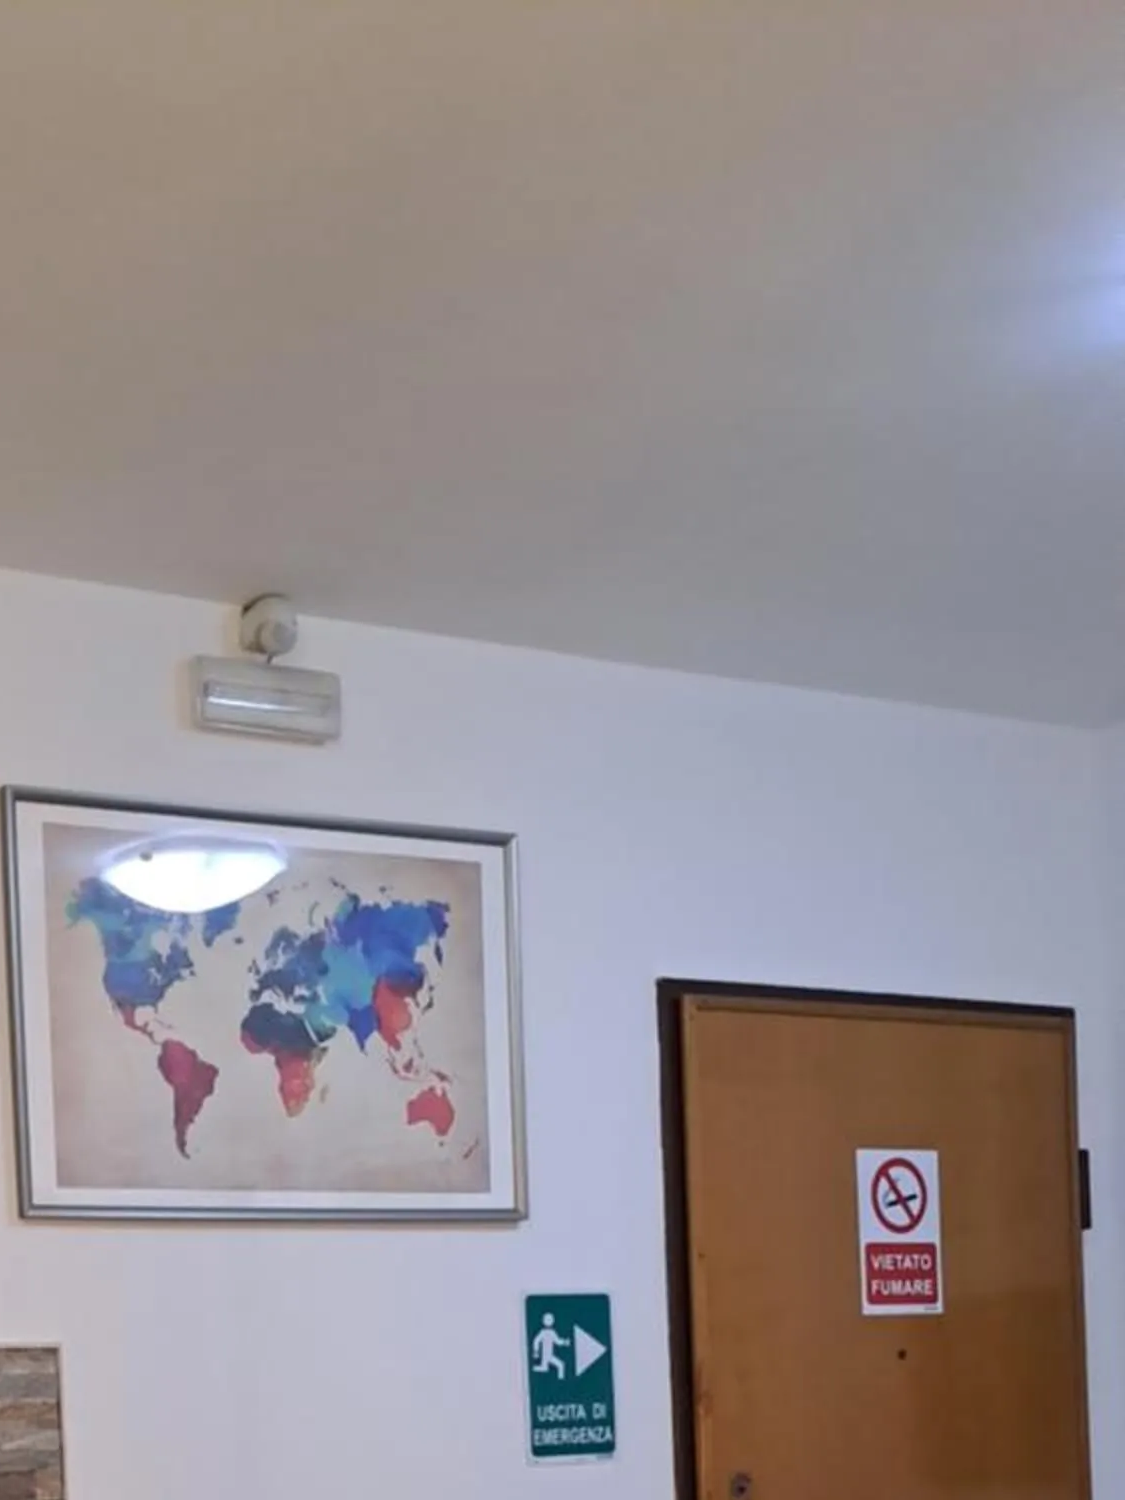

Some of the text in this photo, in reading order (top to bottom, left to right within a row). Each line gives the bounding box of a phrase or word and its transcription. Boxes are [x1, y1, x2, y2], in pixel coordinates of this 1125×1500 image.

[870, 1253, 932, 1270] VIETATO
[871, 1279, 933, 1296] FUMARE
[536, 1402, 607, 1422] USCITA DI
[533, 1426, 613, 1446] EMERGENZA
